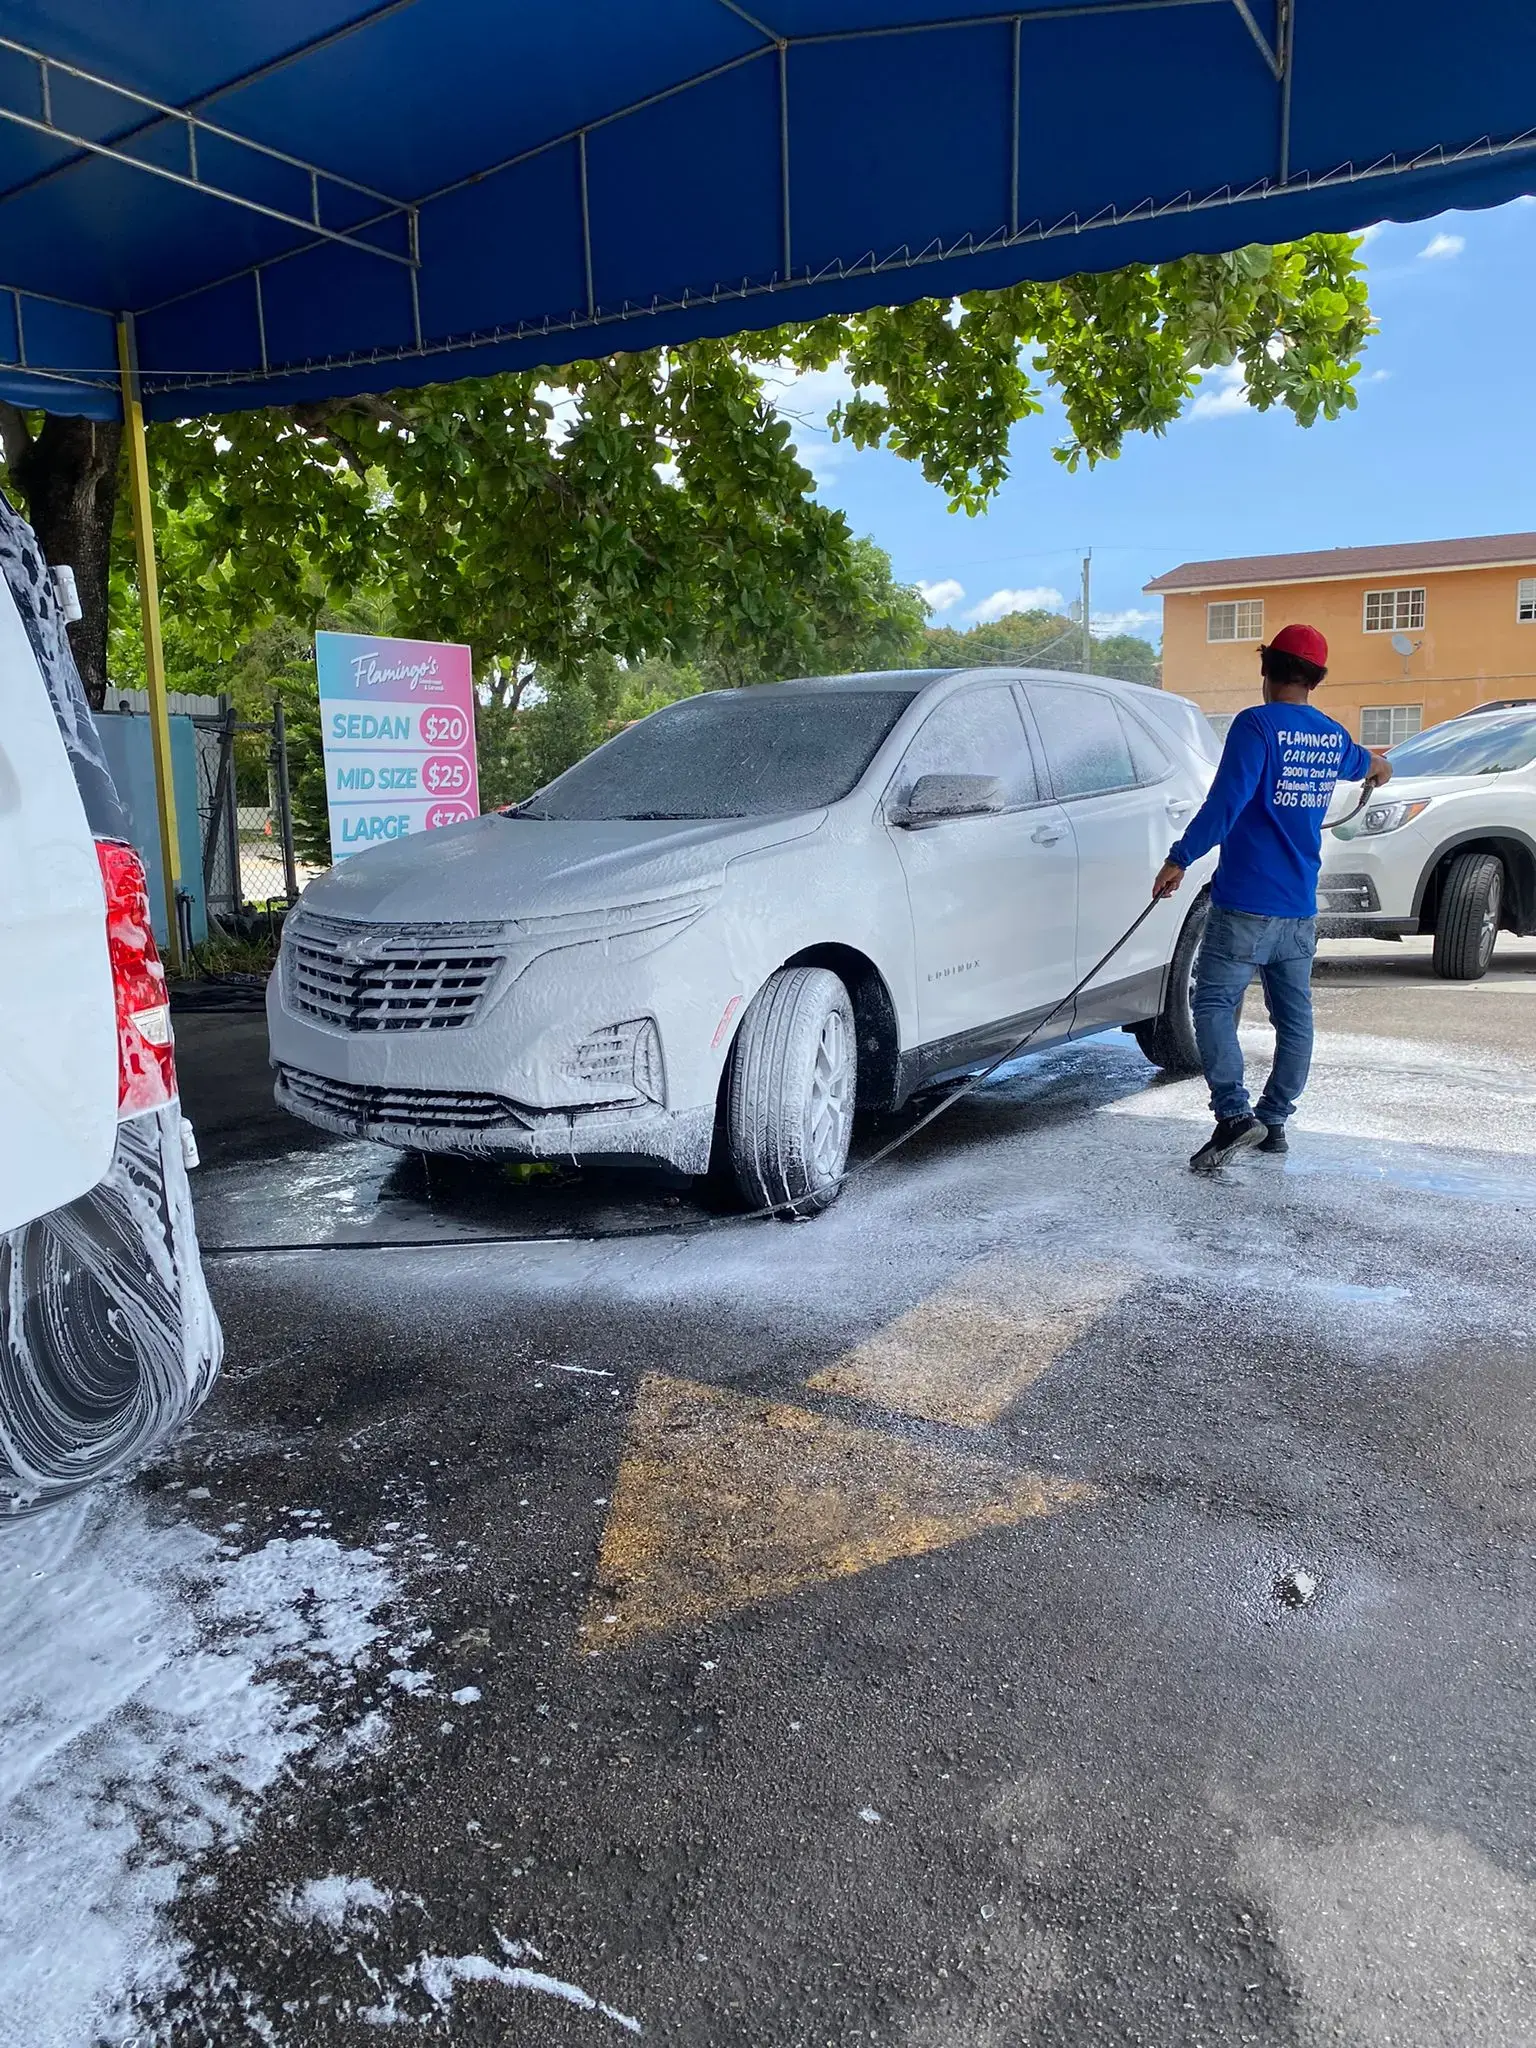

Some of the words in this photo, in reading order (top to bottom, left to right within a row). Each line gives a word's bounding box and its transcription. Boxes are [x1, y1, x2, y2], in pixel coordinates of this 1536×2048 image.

[351, 652, 438, 691] Flamingo's
[332, 713, 410, 739] SEDAN
[426, 713, 463, 742] $20
[1277, 730, 1343, 749] FLAMINGO'S
[1283, 749, 1341, 765] CARWASH
[337, 767, 375, 790] MID
[378, 767, 418, 790] SIZE
[428, 762, 464, 791] $25
[1282, 766, 1303, 777] 2900
[1310, 767, 1326, 778] 2nd
[1309, 781, 1317, 792] FL
[1273, 791, 1299, 807] 305
[342, 815, 410, 842] LARGE
